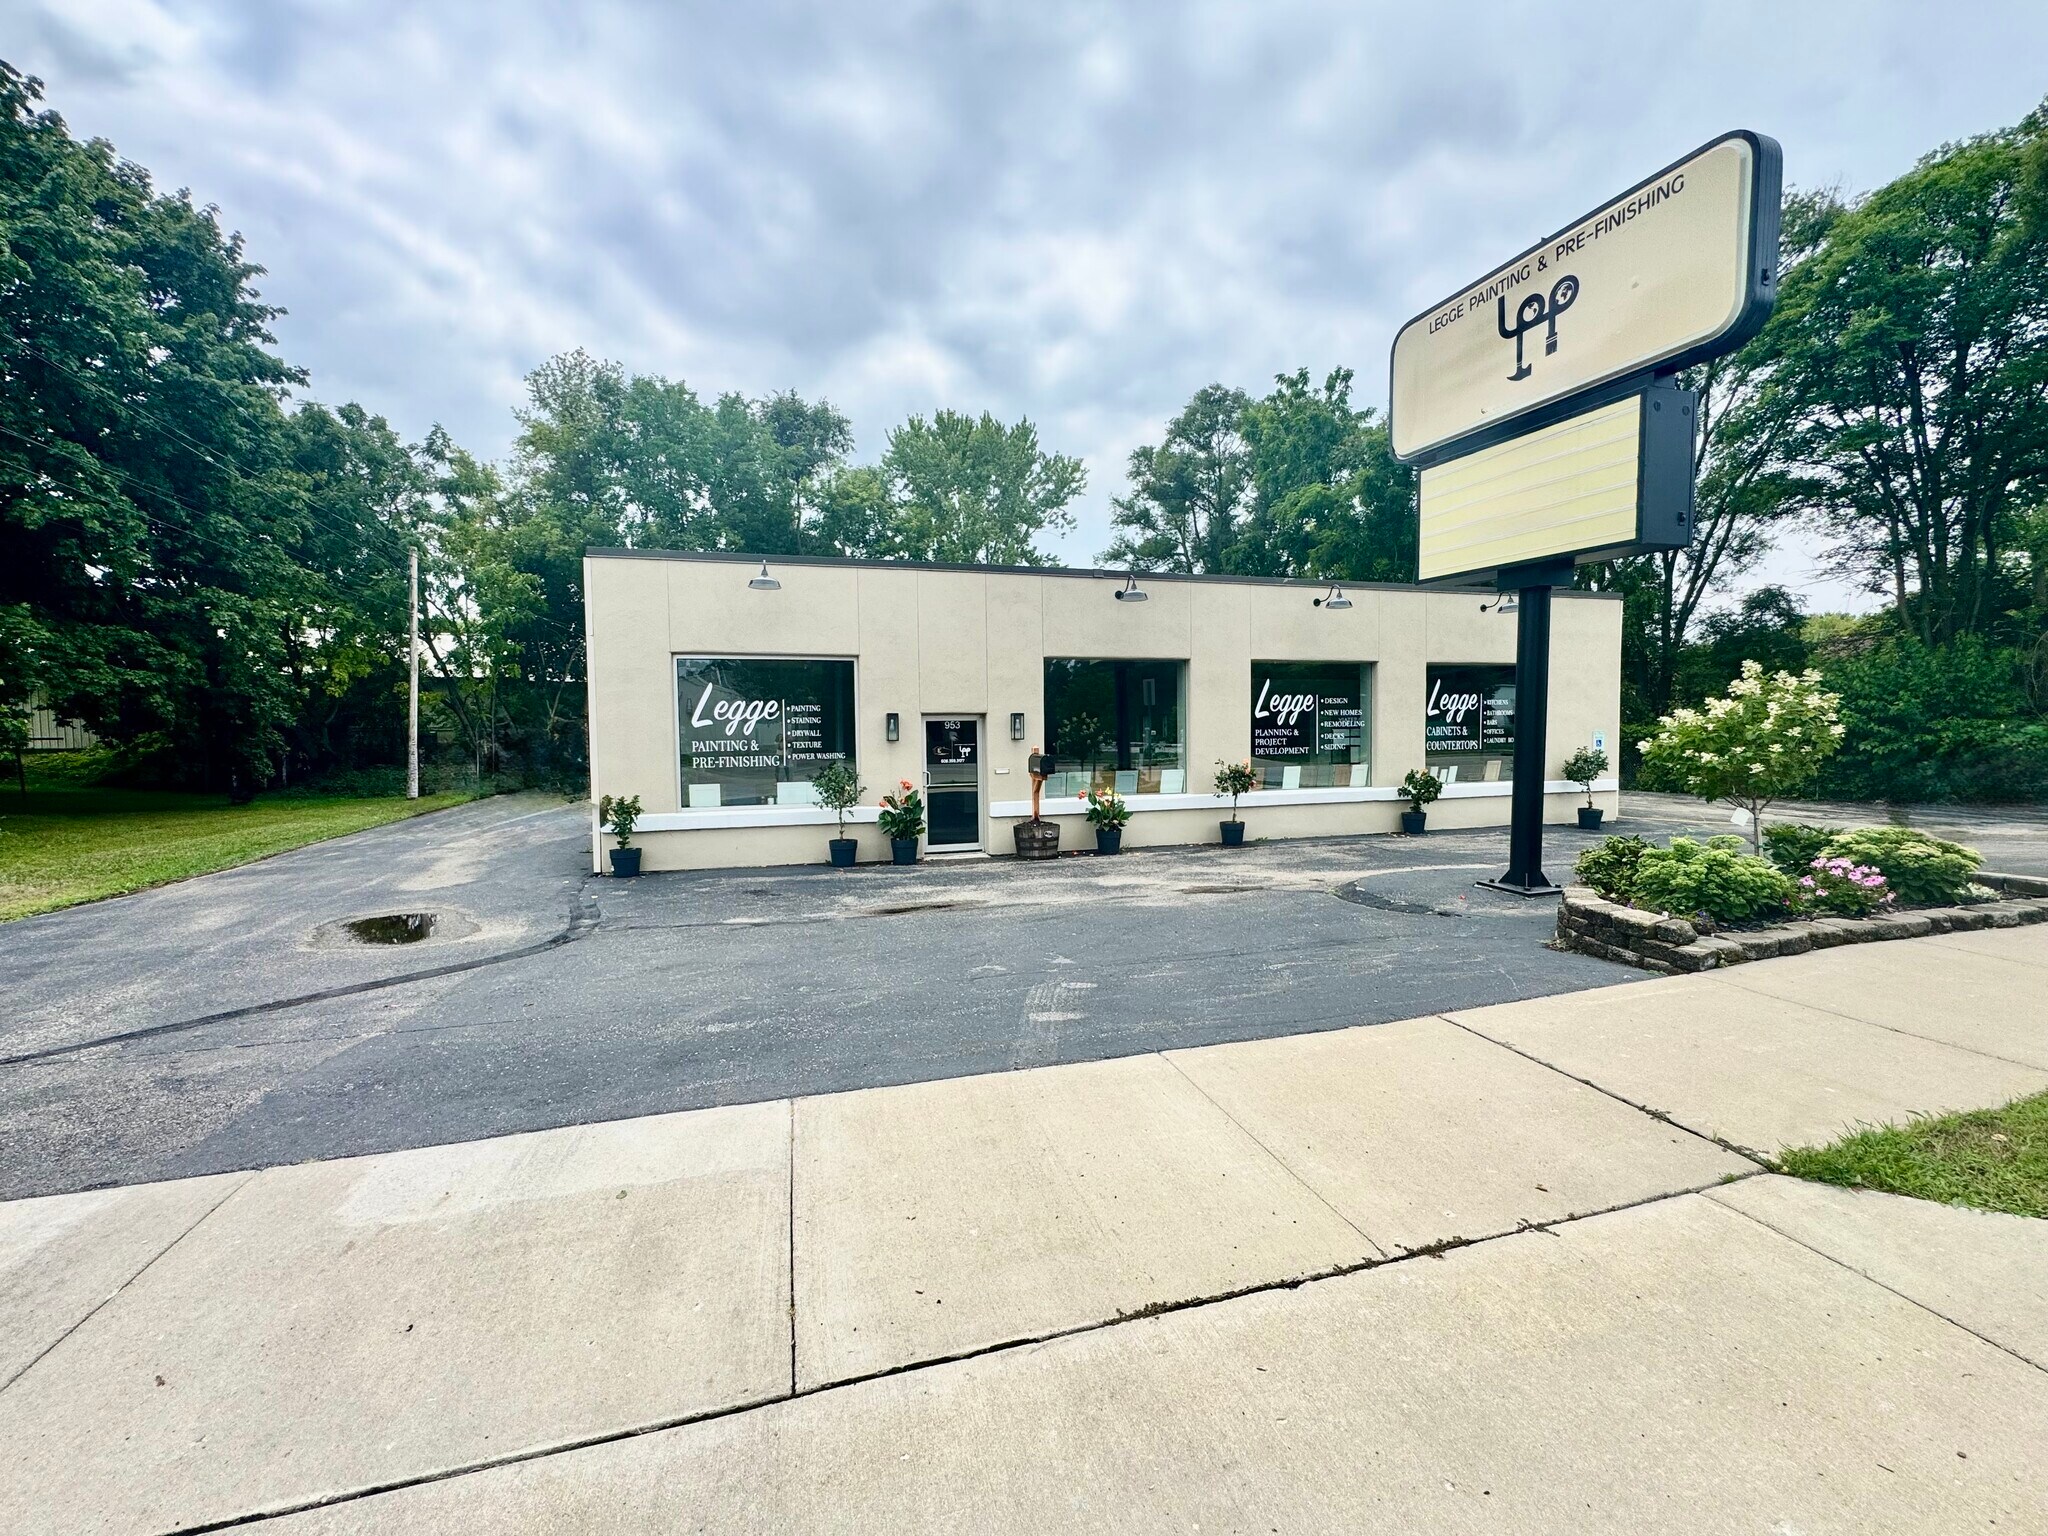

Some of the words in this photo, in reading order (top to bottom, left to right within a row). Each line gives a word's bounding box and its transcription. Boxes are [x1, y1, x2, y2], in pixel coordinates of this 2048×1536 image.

[1429, 304, 1464, 334] LEGGE
[1469, 265, 1530, 311] PAINTING
[1537, 255, 1548, 272] &
[1556, 174, 1685, 261] PRE-FINISHING
[1254, 678, 1315, 726] Legge
[1427, 679, 1478, 723] Legge
[691, 682, 780, 736] Legge
[944, 720, 961, 729] 953
[1324, 720, 1366, 728] REMODELING
[1324, 732, 1345, 740] DECKS
[1427, 726, 1461, 736] CABINETS
[1462, 726, 1468, 735] &
[692, 740, 748, 752] PAINTING
[750, 740, 760, 751] &
[792, 741, 823, 749] TEXTURE
[1255, 738, 1288, 746] PROJECT
[1427, 740, 1479, 751] COUNTERTOPS
[1255, 746, 1310, 755] DEVELOPMENT
[816, 752, 846, 760] WASHING
[692, 755, 780, 769] PRE-FINISHING
